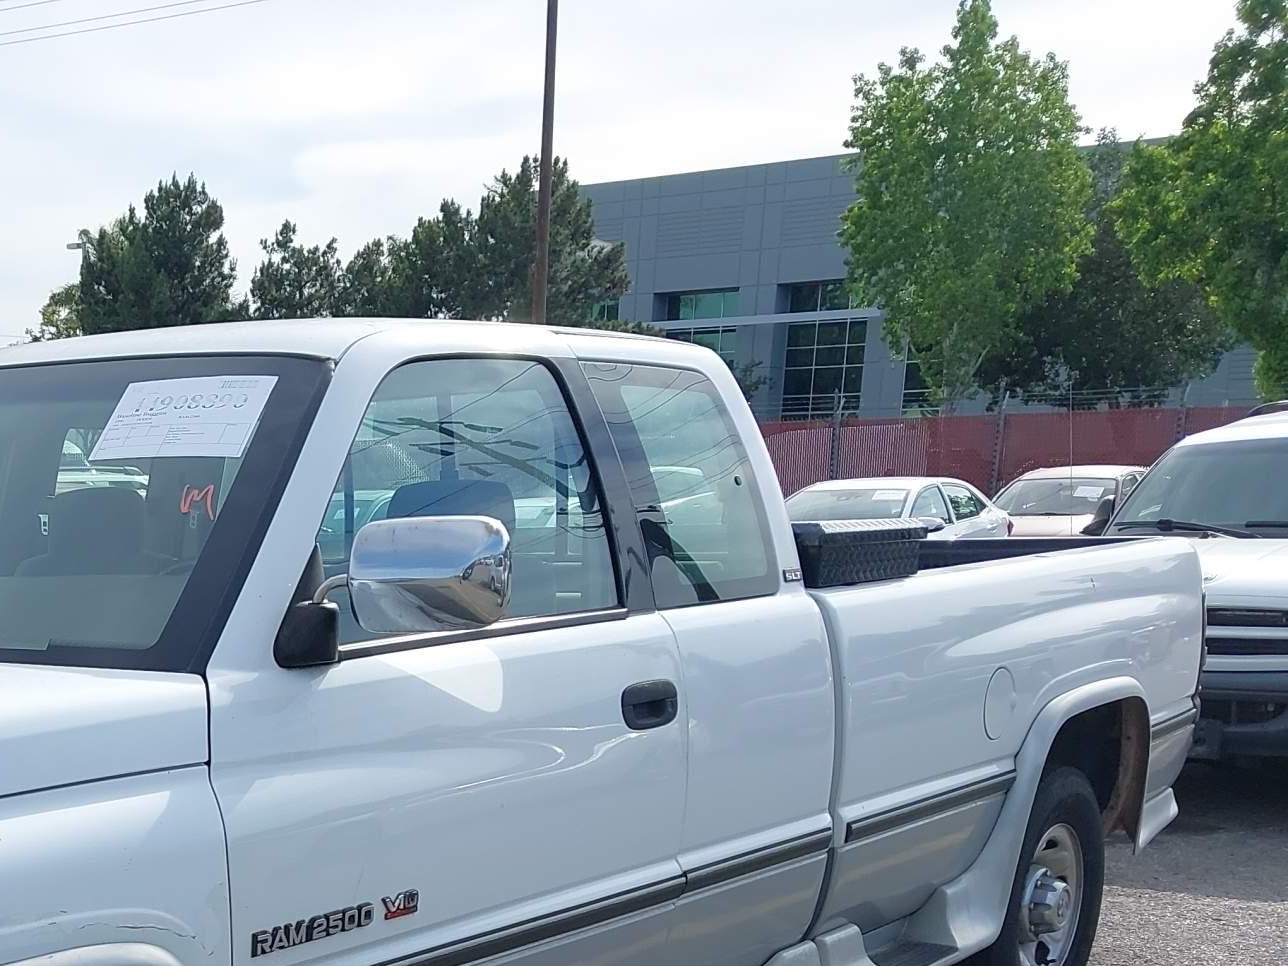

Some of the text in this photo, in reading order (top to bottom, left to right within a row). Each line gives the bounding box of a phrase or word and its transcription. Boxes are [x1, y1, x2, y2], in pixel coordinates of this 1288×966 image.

[784, 570, 802, 582] SLT
[251, 921, 307, 958] RAM
[308, 902, 375, 941] 2500
